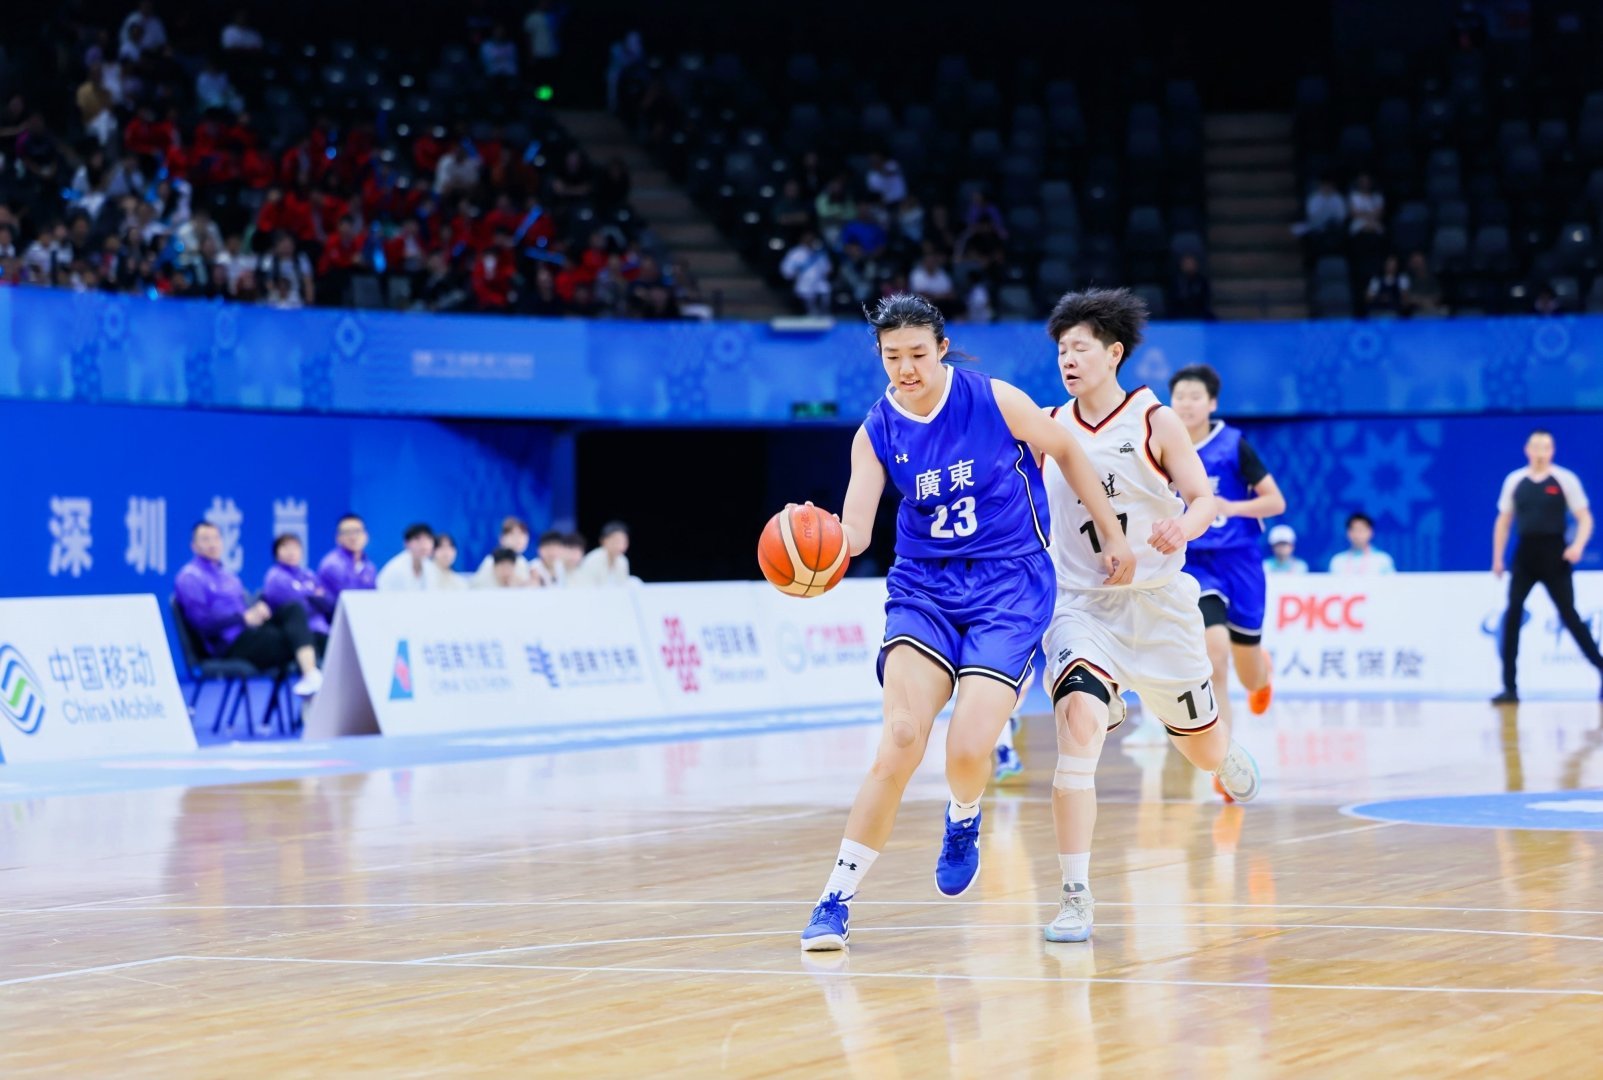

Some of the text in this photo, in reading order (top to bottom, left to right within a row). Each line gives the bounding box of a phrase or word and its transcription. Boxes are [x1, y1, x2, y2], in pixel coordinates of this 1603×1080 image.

[916, 459, 975, 500] 廣東
[930, 496, 978, 539] 23
[1277, 594, 1366, 631] PICC
[48, 642, 156, 692] 中国移动
[1268, 647, 1425, 678] 人民保险
[62, 696, 167, 724] China Mobile
